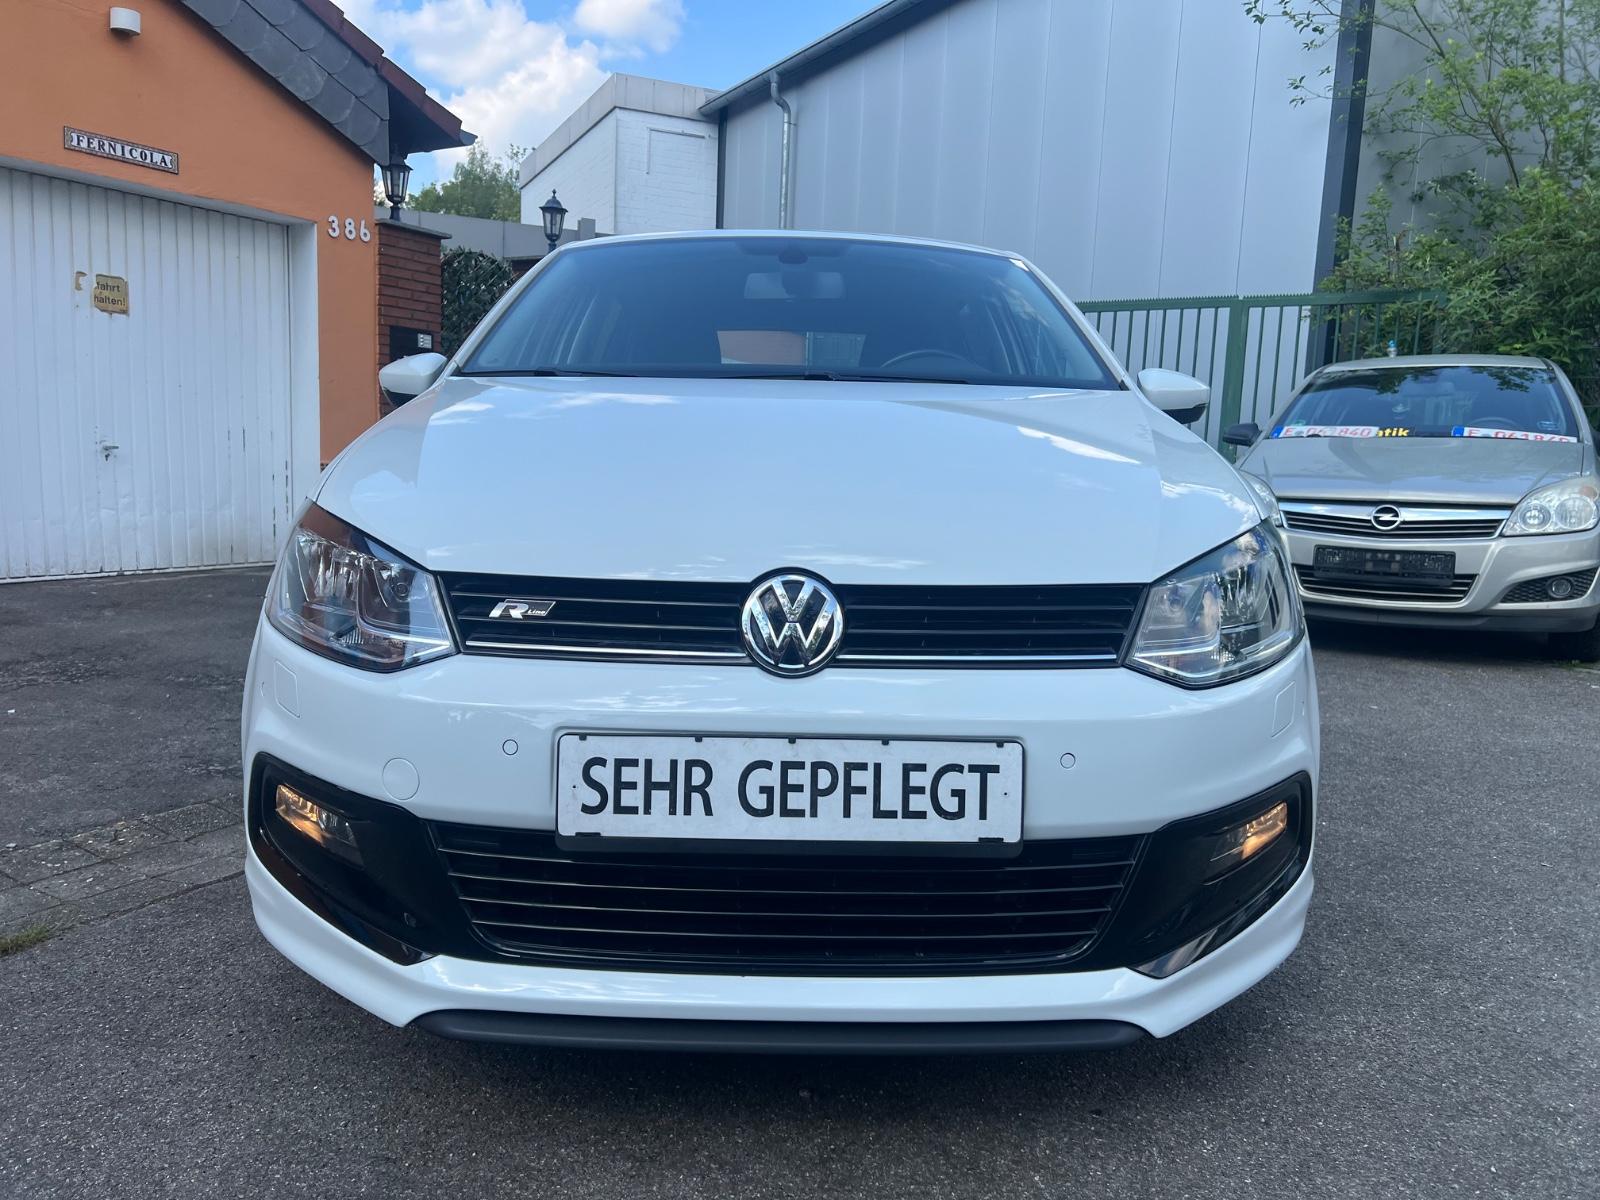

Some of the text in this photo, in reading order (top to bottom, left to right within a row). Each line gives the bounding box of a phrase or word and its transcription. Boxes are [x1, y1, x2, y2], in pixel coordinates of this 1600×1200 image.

[76, 133, 169, 167] FERNICOLA
[328, 215, 371, 242] 386
[489, 602, 529, 619] R
[581, 757, 1000, 820] SEHR GEPFLEGT
